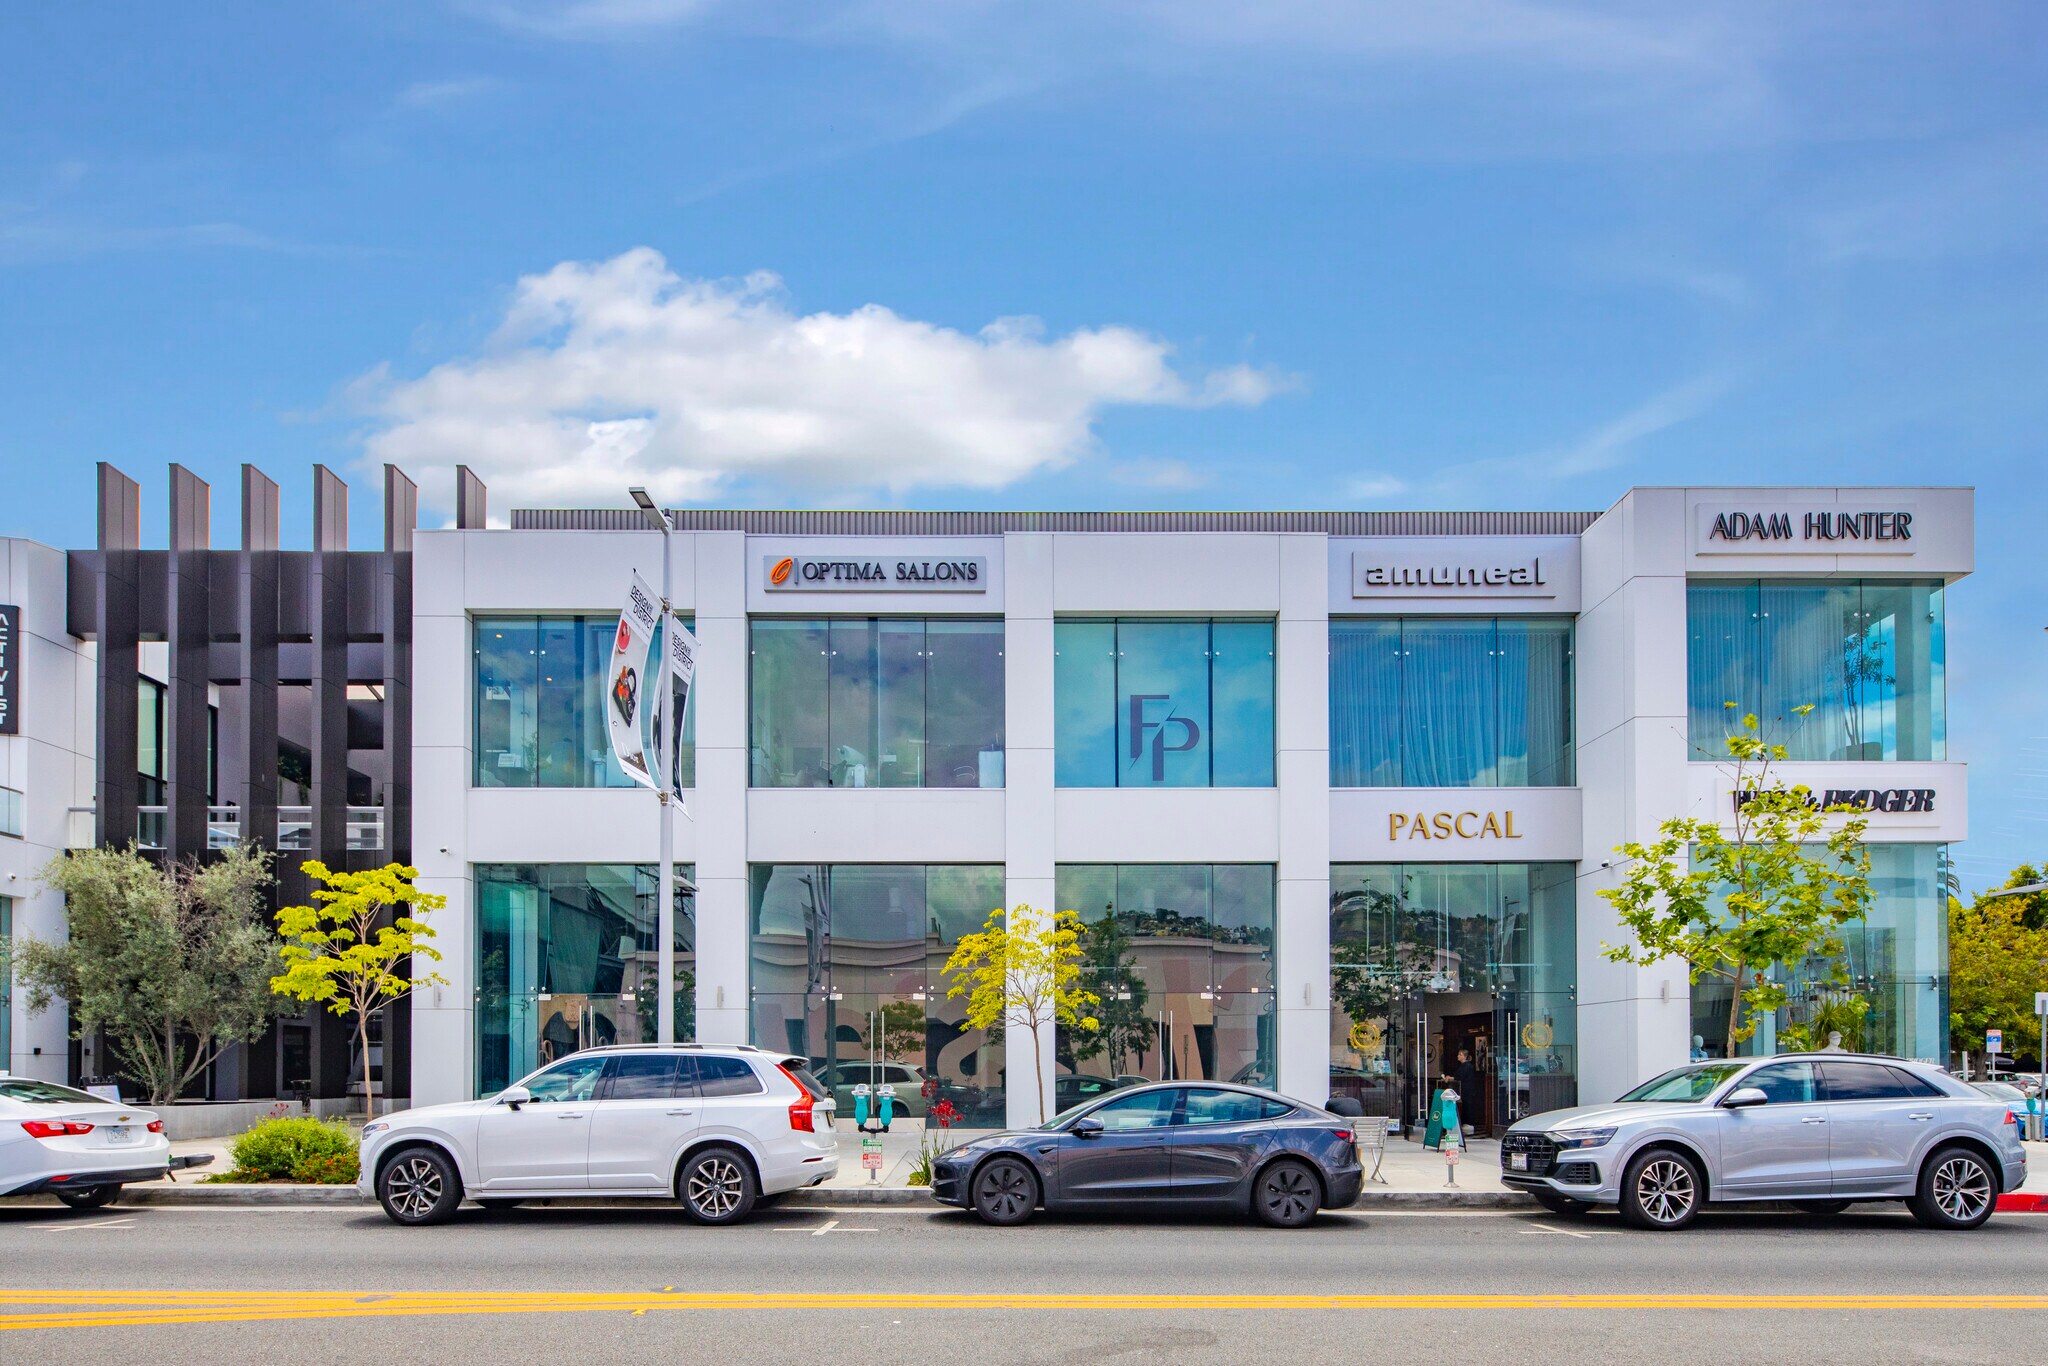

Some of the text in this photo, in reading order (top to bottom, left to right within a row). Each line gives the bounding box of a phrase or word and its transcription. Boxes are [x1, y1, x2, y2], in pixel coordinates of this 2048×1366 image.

[1710, 512, 1912, 540] ADAM HUNTER
[802, 562, 978, 581] OPTIMA SALONS
[1366, 557, 1546, 585] amuneal
[630, 585, 651, 612] DESIGN
[1389, 810, 1523, 840] PASCAL
